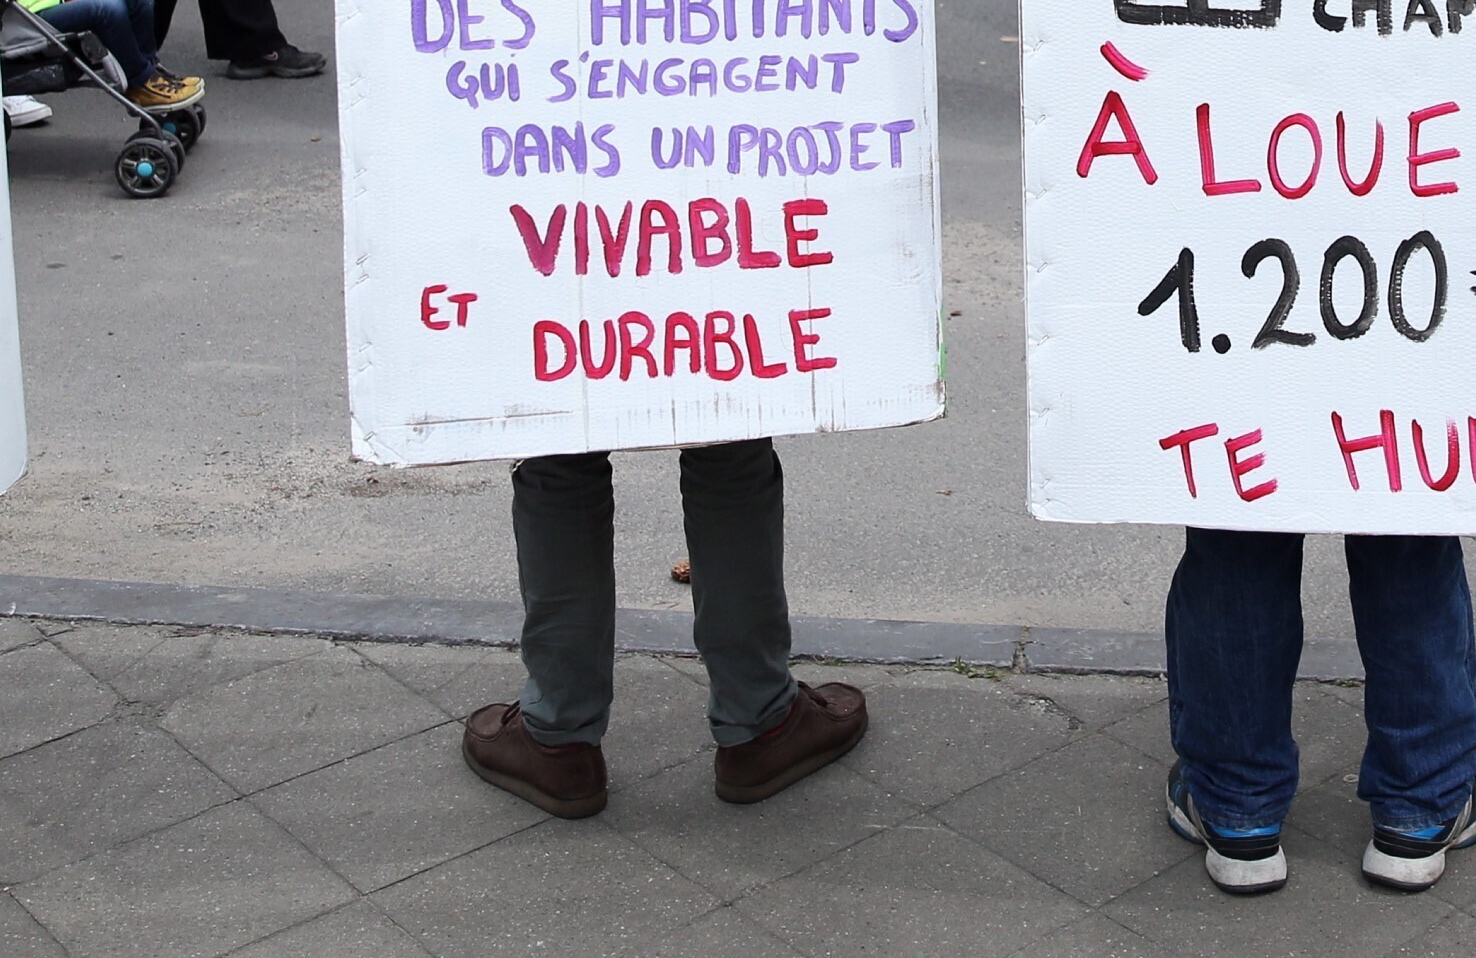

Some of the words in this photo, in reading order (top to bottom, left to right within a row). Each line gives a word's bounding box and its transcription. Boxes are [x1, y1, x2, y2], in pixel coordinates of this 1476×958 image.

[548, 51, 859, 102] S'ENGAGENT
[482, 122, 621, 177] DANS
[651, 125, 715, 170] UN
[727, 120, 916, 177] PROJET
[1077, 42, 1157, 185] À
[510, 198, 833, 277] VIVABLE
[421, 285, 477, 330] ET
[534, 308, 836, 381] DURABLE
[1160, 423, 1277, 501] TE
